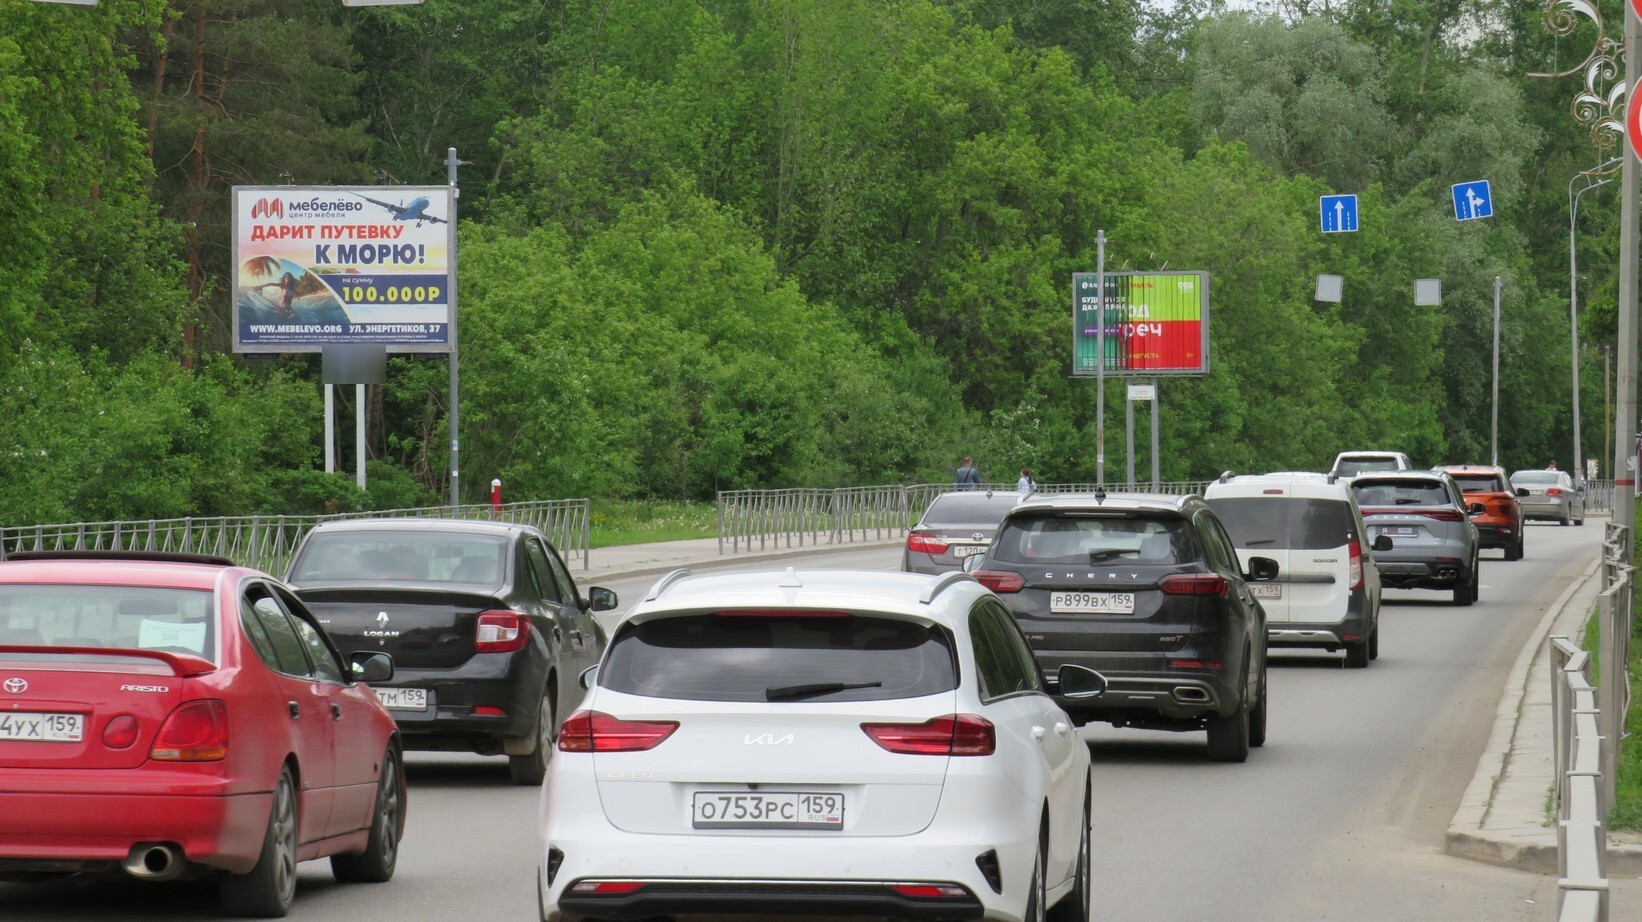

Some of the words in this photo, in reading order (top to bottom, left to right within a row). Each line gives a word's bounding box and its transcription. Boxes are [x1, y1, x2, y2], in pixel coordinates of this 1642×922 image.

[289, 197, 363, 212] мебелёво
[251, 225, 316, 241] ДАРИТ
[320, 225, 405, 240] ПУТЕВКУ
[315, 244, 331, 264] К
[337, 244, 425, 265] МОРЮ!
[250, 325, 342, 333] WWW.MEBELEVO.ORG
[349, 325, 364, 333] УЛ.
[365, 325, 427, 334] ЭНЕРГЕТИКОВ,
[429, 325, 441, 333] 37
[1110, 594, 1131, 604] 159
[120, 684, 169, 693] ARISTO
[377, 692, 397, 704] ТМ
[400, 690, 422, 701] 159
[46, 715, 77, 732] 159
[743, 733, 794, 745] KIA
[701, 796, 794, 819] О753РС
[801, 796, 836, 814] 159
[808, 814, 826, 822] RUS
